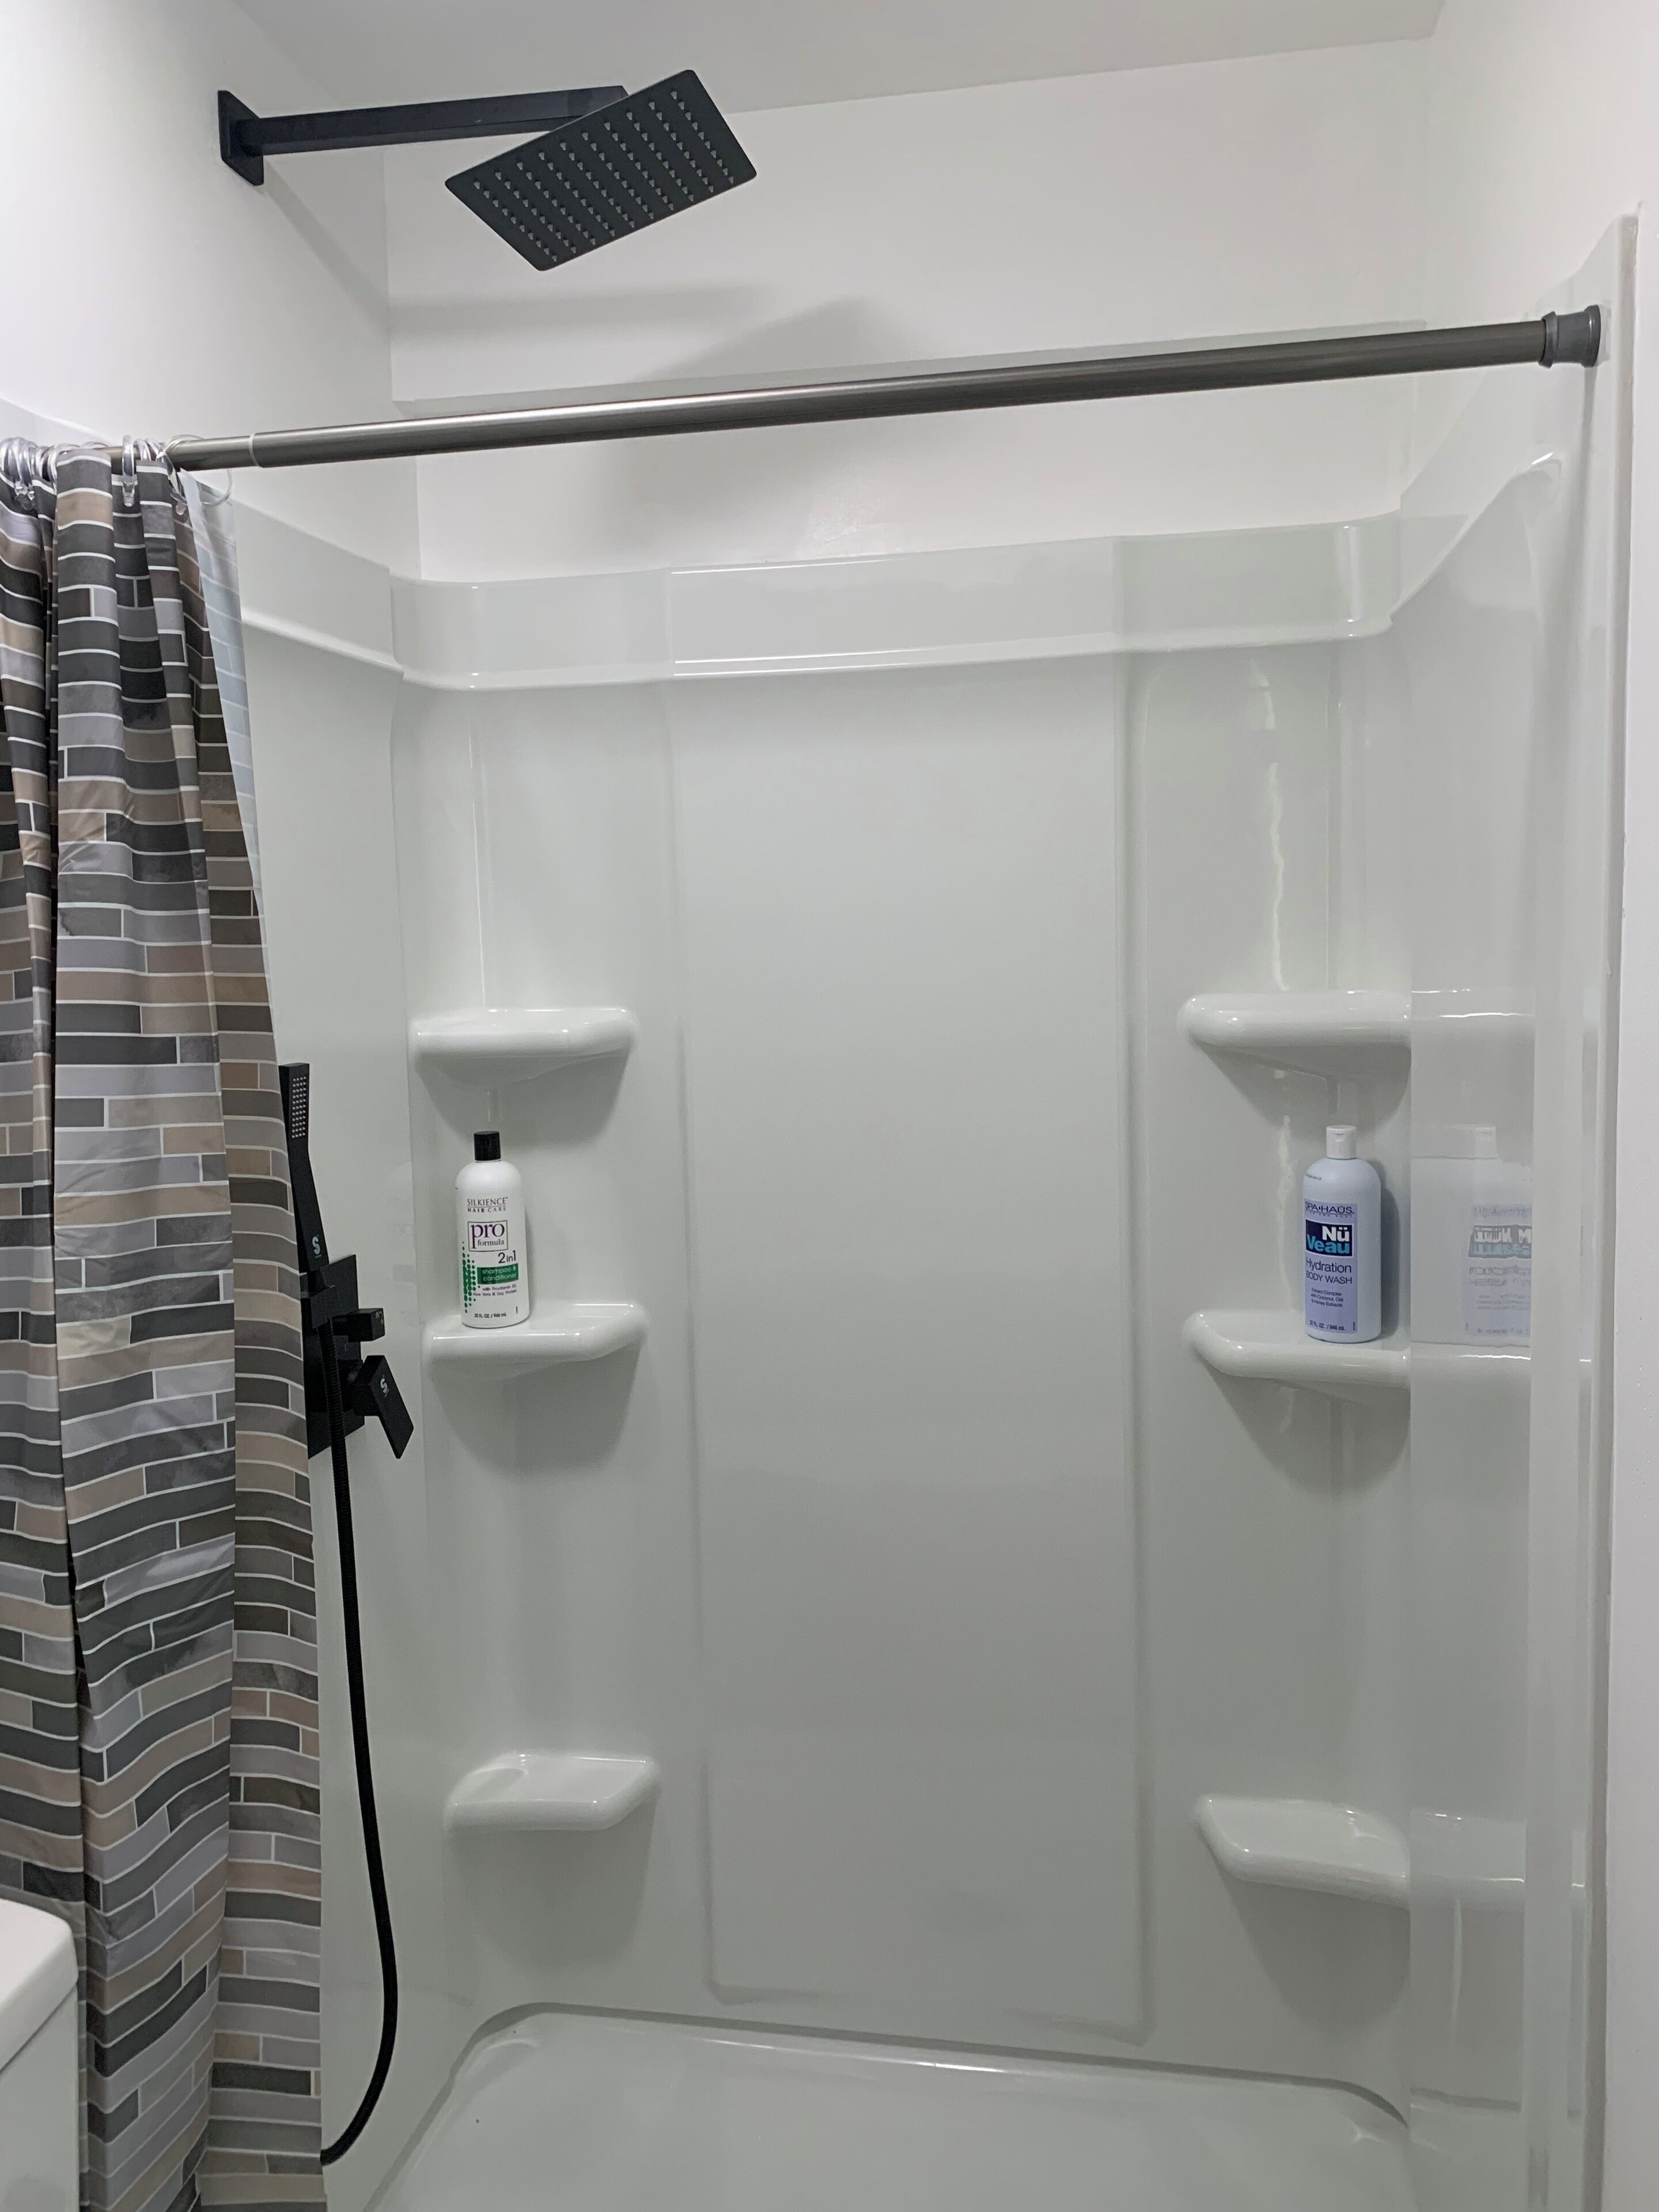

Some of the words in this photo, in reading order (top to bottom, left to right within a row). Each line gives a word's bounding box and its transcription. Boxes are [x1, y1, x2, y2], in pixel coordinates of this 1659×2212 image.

[467, 1198, 506, 1206] SILKIENCE
[471, 1224, 505, 1249] pro
[1322, 1226, 1350, 1242] Nü
[1307, 1234, 1350, 1254] Veau
[1306, 1257, 1352, 1273] Hydration
[483, 1273, 517, 1281] conditioner
[1306, 1270, 1323, 1282] BODY
[1325, 1275, 1352, 1285] WASH
